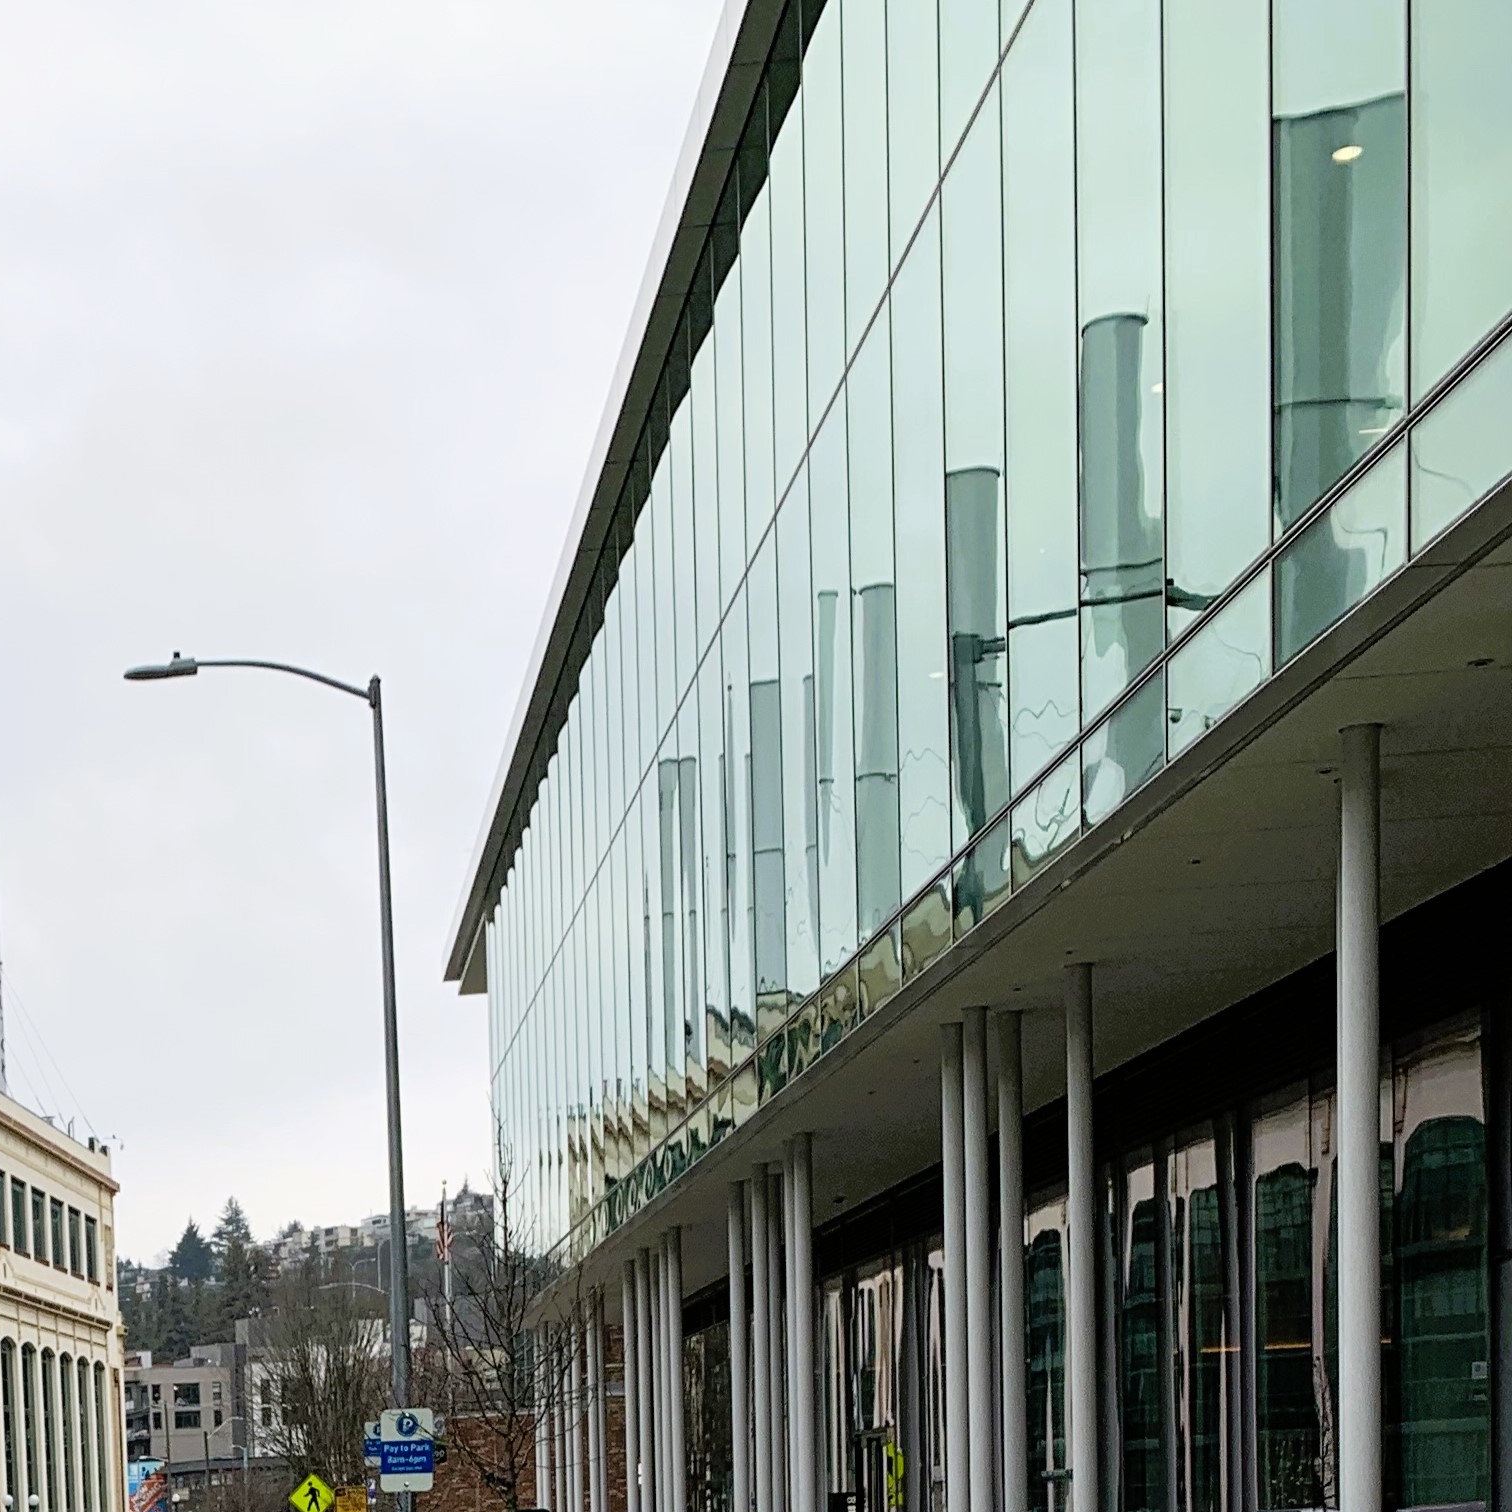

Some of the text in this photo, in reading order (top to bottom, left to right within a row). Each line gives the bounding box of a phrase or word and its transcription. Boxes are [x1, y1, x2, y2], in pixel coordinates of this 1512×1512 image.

[384, 1444, 399, 1454] Pay
[400, 1444, 409, 1452] to
[410, 1443, 430, 1451] Park
